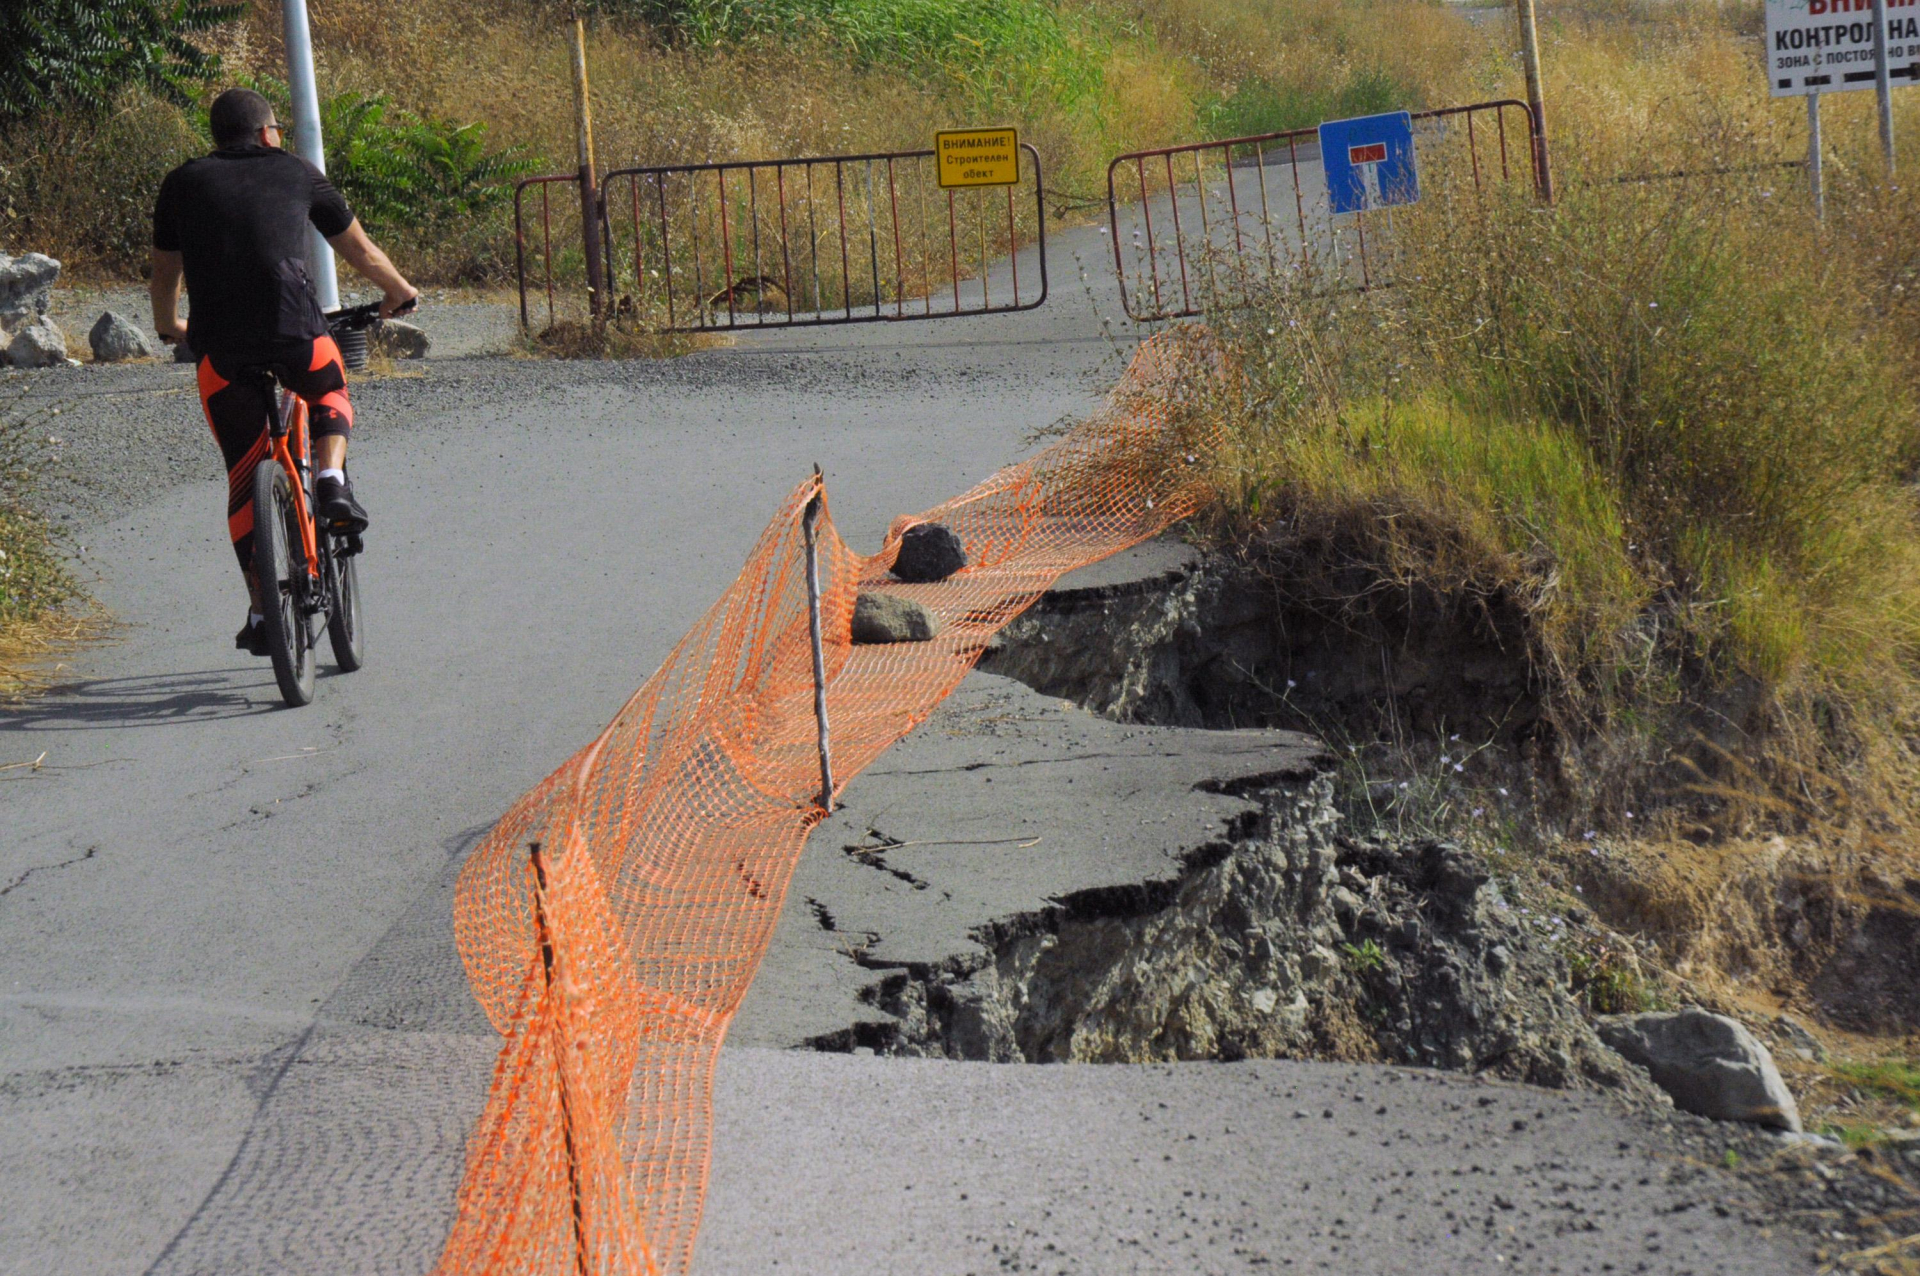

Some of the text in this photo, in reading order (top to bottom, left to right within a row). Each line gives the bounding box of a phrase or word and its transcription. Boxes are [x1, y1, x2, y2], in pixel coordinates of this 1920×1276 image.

[1777, 55, 1810, 69] ЗОНА
[1813, 54, 1822, 66] С
[1826, 46, 1903, 65] ПОСТОЯНО
[943, 136, 1011, 150] ВНИМАНИЕ!
[946, 153, 1009, 167] Строителен
[963, 169, 994, 179] обект
